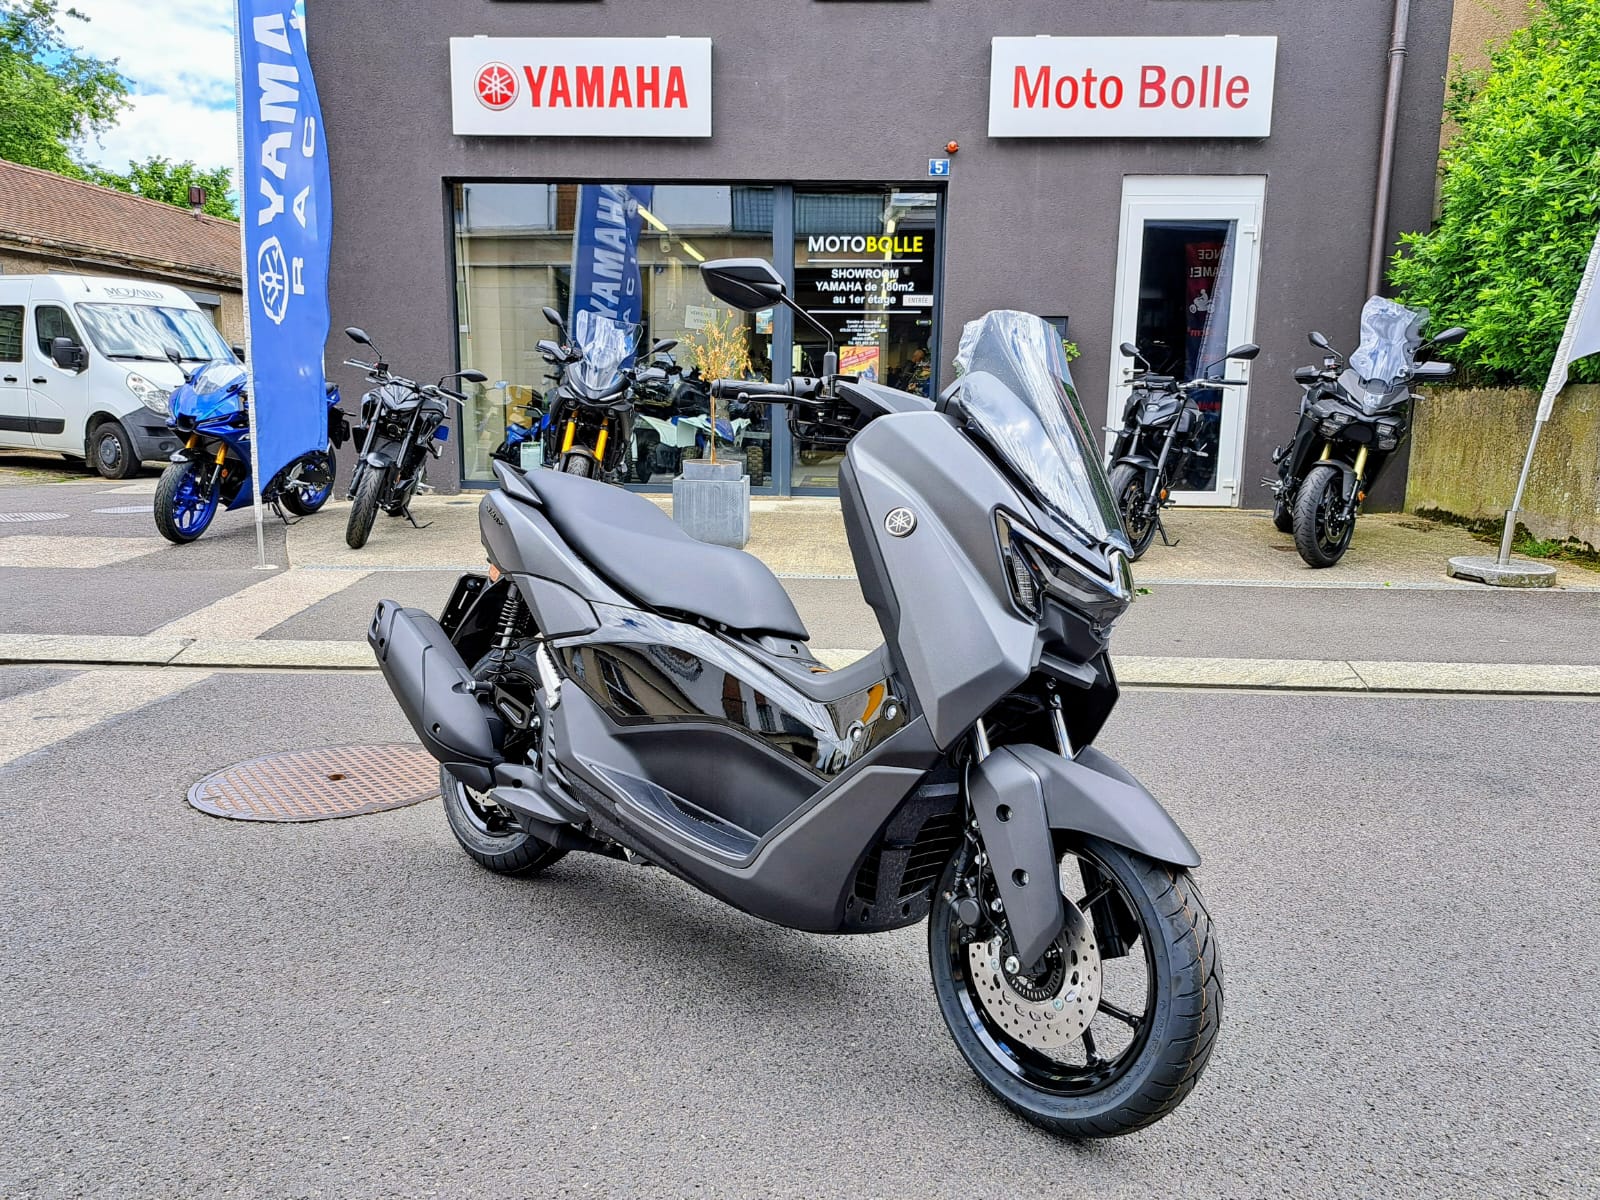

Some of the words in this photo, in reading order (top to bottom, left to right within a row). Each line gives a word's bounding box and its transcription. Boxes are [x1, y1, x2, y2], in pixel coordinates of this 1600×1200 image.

[523, 65, 689, 108] YAMAHA
[1012, 65, 1124, 109] Moto
[1138, 65, 1250, 109] Bolle
[933, 161, 944, 174] 5
[808, 236, 923, 253] MOTOBOLLE
[831, 268, 900, 280] SHOWROOM
[815, 281, 863, 292] YAMAHA
[864, 281, 878, 292] de
[880, 281, 915, 292] 180m2
[833, 295, 846, 304] au
[848, 294, 865, 304] 1er
[867, 294, 897, 307] étage
